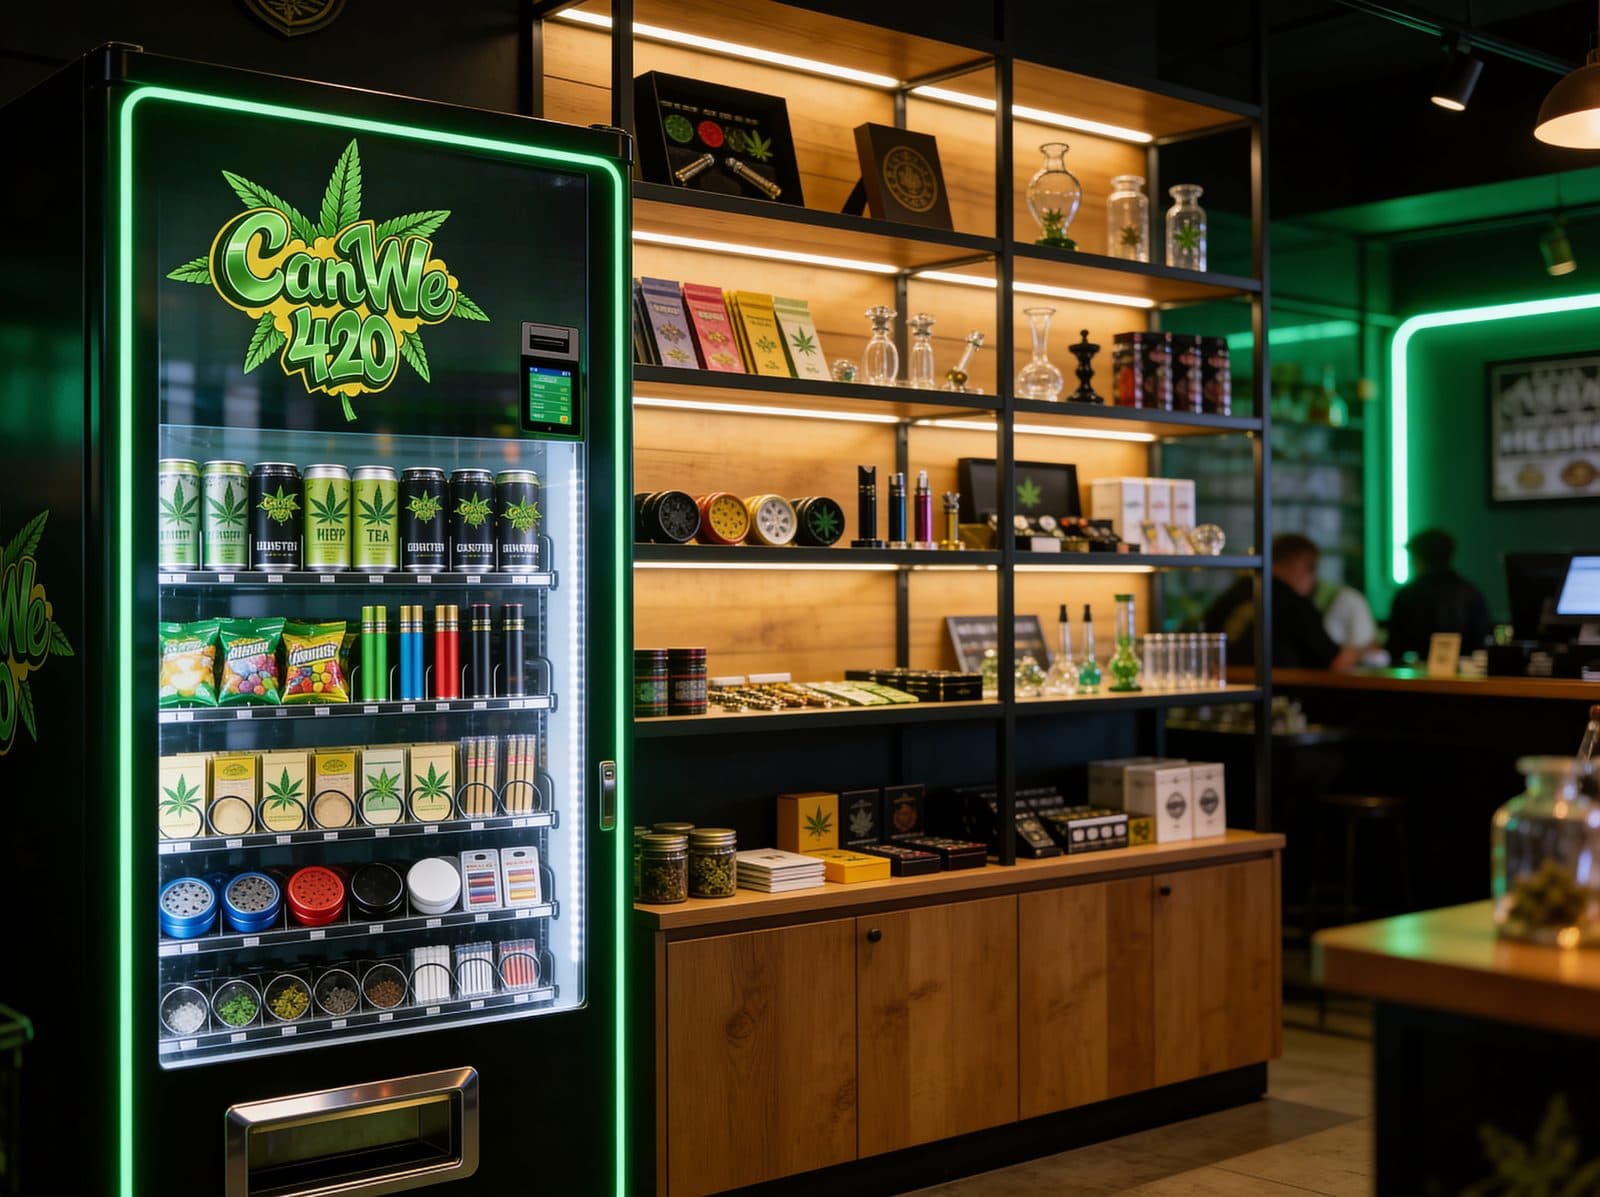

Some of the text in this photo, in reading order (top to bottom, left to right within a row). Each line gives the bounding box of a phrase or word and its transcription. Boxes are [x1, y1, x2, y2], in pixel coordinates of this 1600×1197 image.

[222, 209, 456, 317] CanWe
[286, 306, 397, 384] 420
[366, 529, 389, 543] TEA
